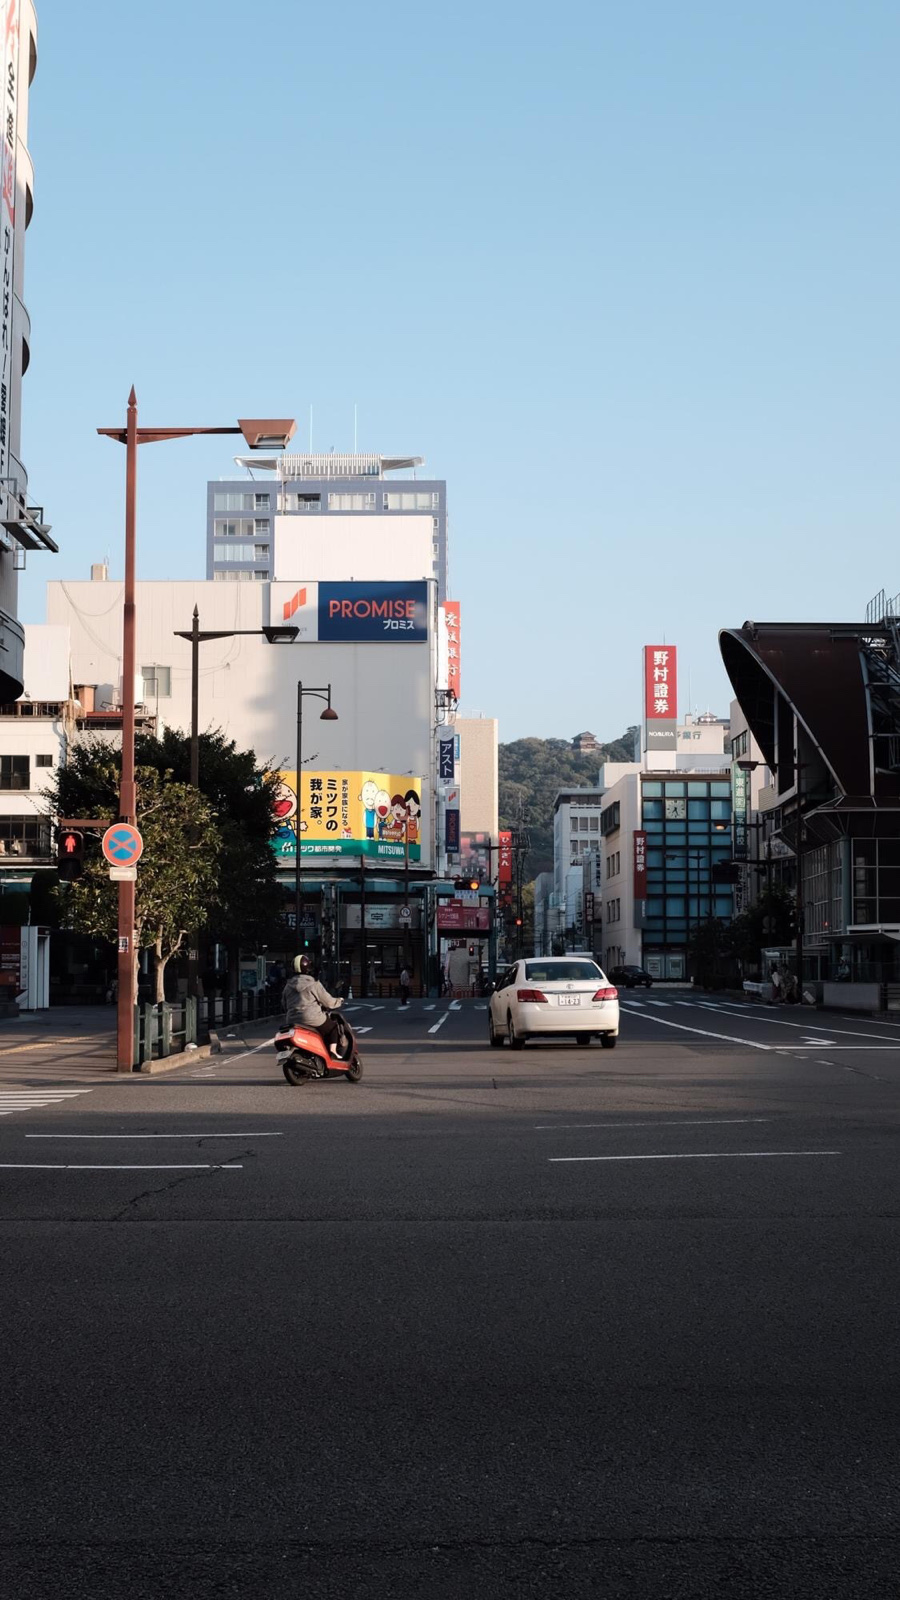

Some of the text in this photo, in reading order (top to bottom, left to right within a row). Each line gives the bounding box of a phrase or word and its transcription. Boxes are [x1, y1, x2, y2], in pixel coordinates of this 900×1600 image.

[329, 600, 416, 618] PROMISE
[383, 620, 415, 630] プロミス
[653, 650, 669, 714] 野村證券
[441, 743, 452, 776] アスト
[310, 778, 323, 826] 我が家。
[326, 778, 338, 832] ミツワの
[378, 844, 405, 856] MITSUWA
